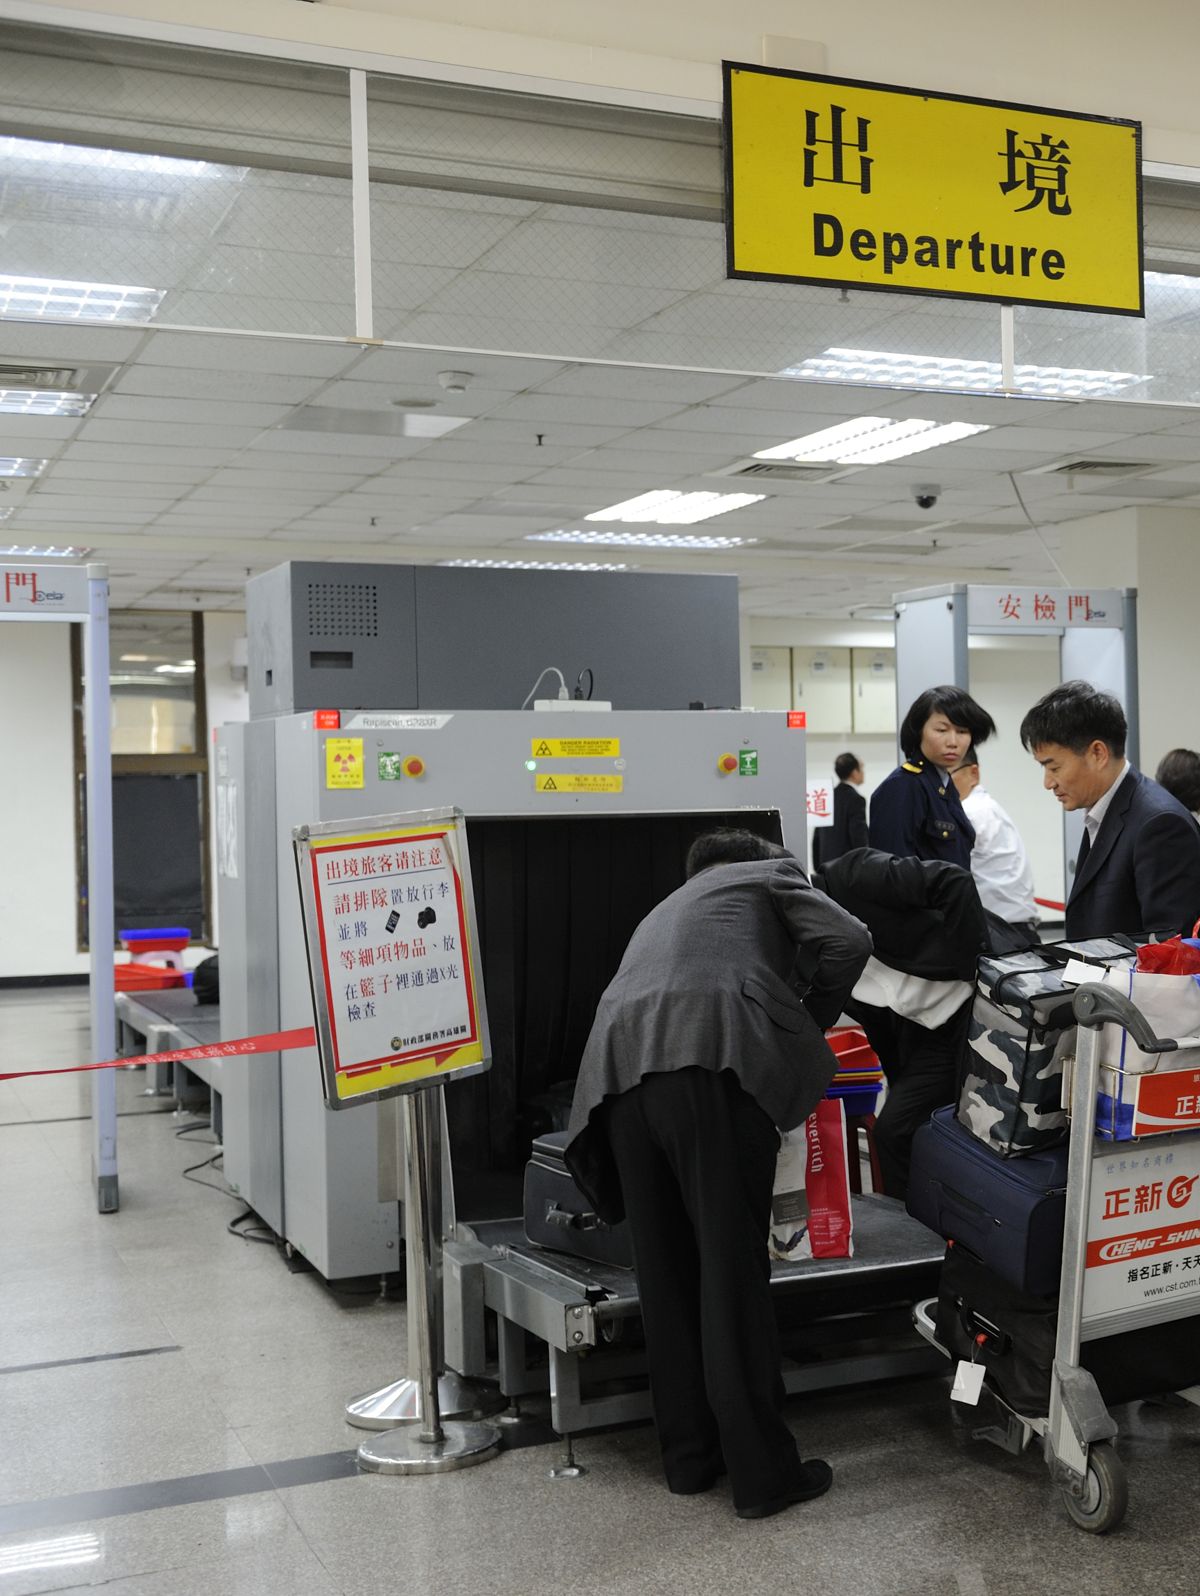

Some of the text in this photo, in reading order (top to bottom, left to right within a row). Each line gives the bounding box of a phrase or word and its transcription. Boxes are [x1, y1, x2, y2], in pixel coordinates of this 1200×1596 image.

[803, 104, 1073, 216] 出境
[813, 212, 1066, 280] Departure
[5, 572, 38, 603] 門
[999, 593, 1090, 621] 安檢門
[334, 882, 449, 915] 請排隊置放行李
[338, 921, 368, 942] 並將
[347, 1002, 377, 1022] 檢查
[808, 1112, 824, 1172] everrich
[1102, 1182, 1163, 1220] 正新
[1099, 1236, 1162, 1261] CHENG
